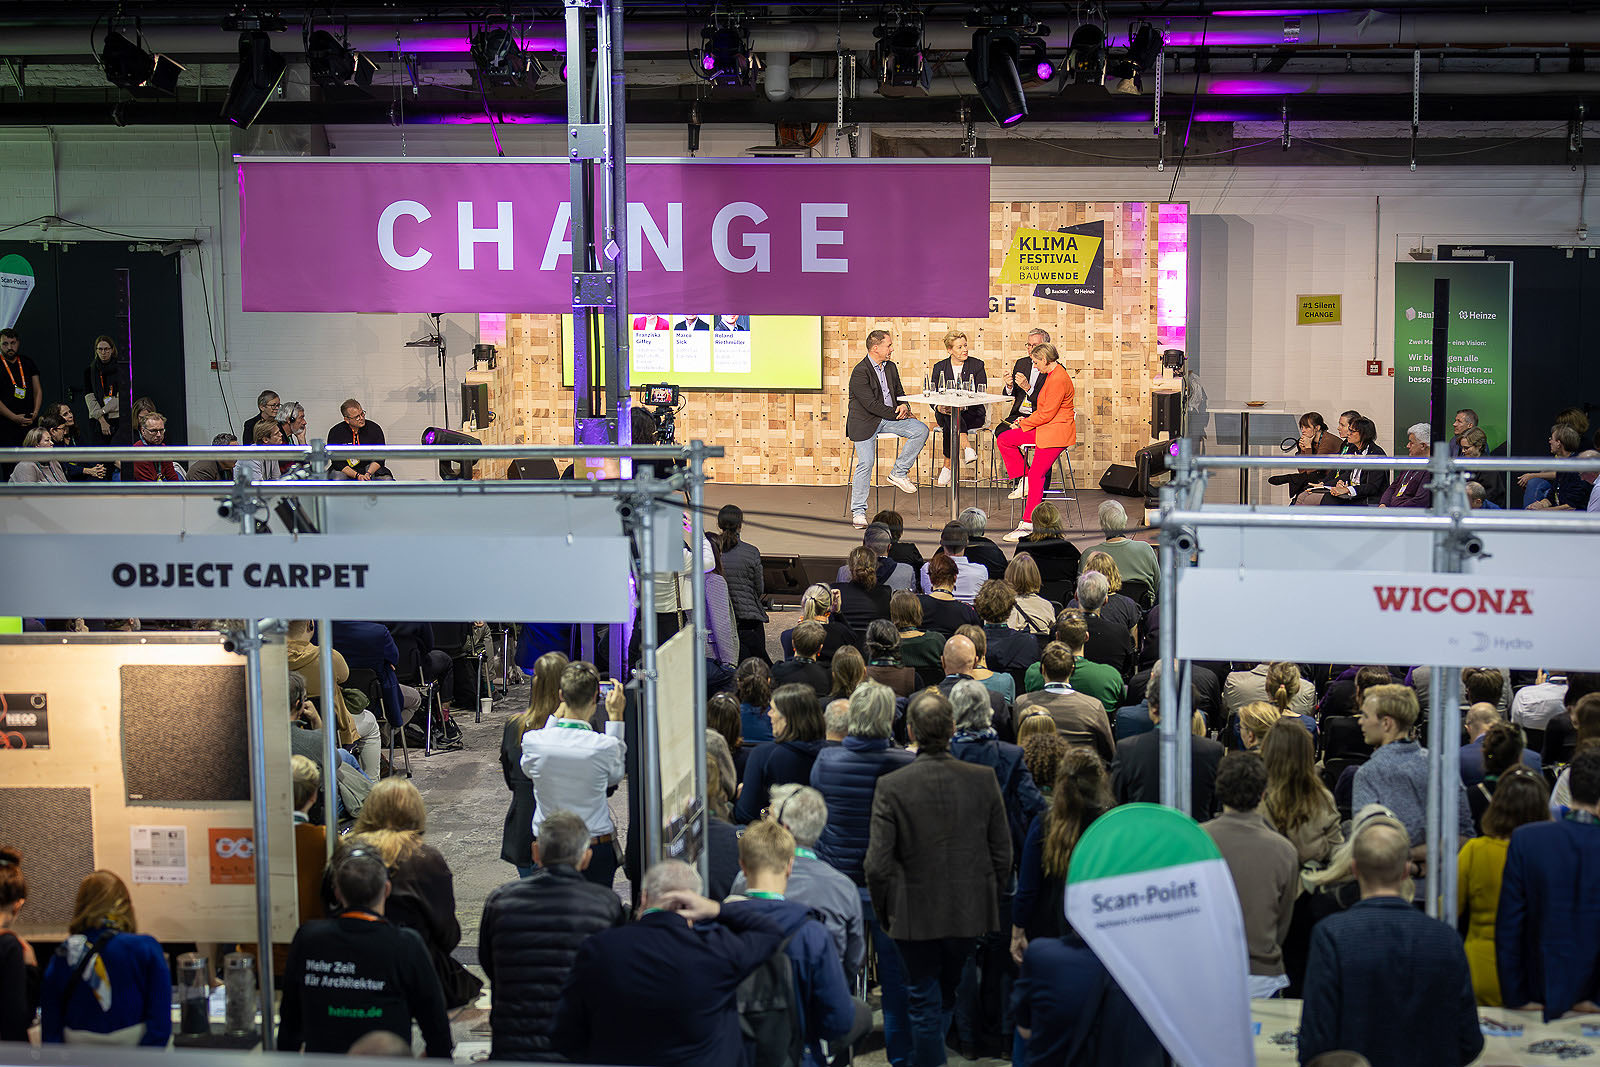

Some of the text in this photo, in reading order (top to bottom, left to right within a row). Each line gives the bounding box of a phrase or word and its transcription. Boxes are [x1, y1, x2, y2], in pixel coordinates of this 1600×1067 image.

[376, 199, 849, 274] CHANGE
[1019, 236, 1079, 251] KLIMA
[1019, 253, 1079, 264] FESTIVAL
[0, 276, 28, 286] Scan-Point
[1019, 272, 1079, 280] BAUWENDE
[1469, 311, 1497, 320] Heinze
[1408, 353, 1422, 361] Wir
[1446, 376, 1496, 385] Ergebnissen.
[112, 563, 369, 588] OBJECT CARPET
[1373, 586, 1534, 615] WICONA
[1092, 880, 1197, 913] Scan-Point
[333, 962, 355, 974] Zeit
[321, 976, 385, 990] Architektur
[328, 1005, 383, 1017] heinze.de
